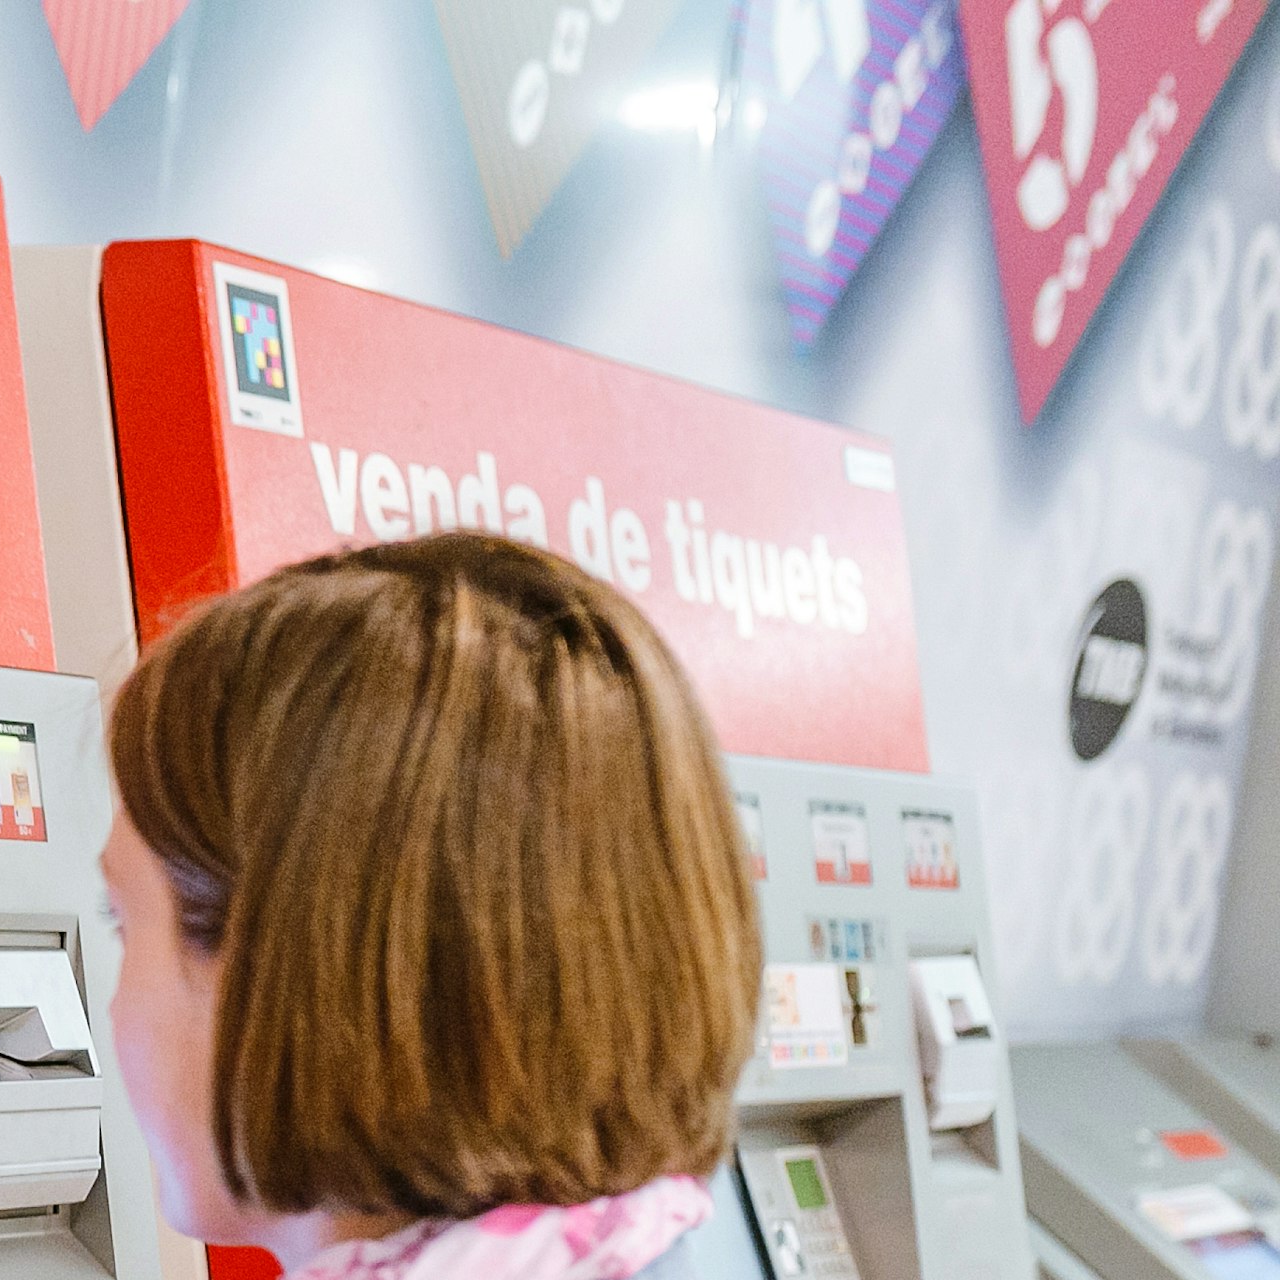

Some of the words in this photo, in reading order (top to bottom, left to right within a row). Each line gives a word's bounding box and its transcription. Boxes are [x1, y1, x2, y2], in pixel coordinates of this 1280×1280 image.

[310, 442, 547, 547] venda
[568, 476, 651, 593] de
[665, 495, 867, 638] tiquets
